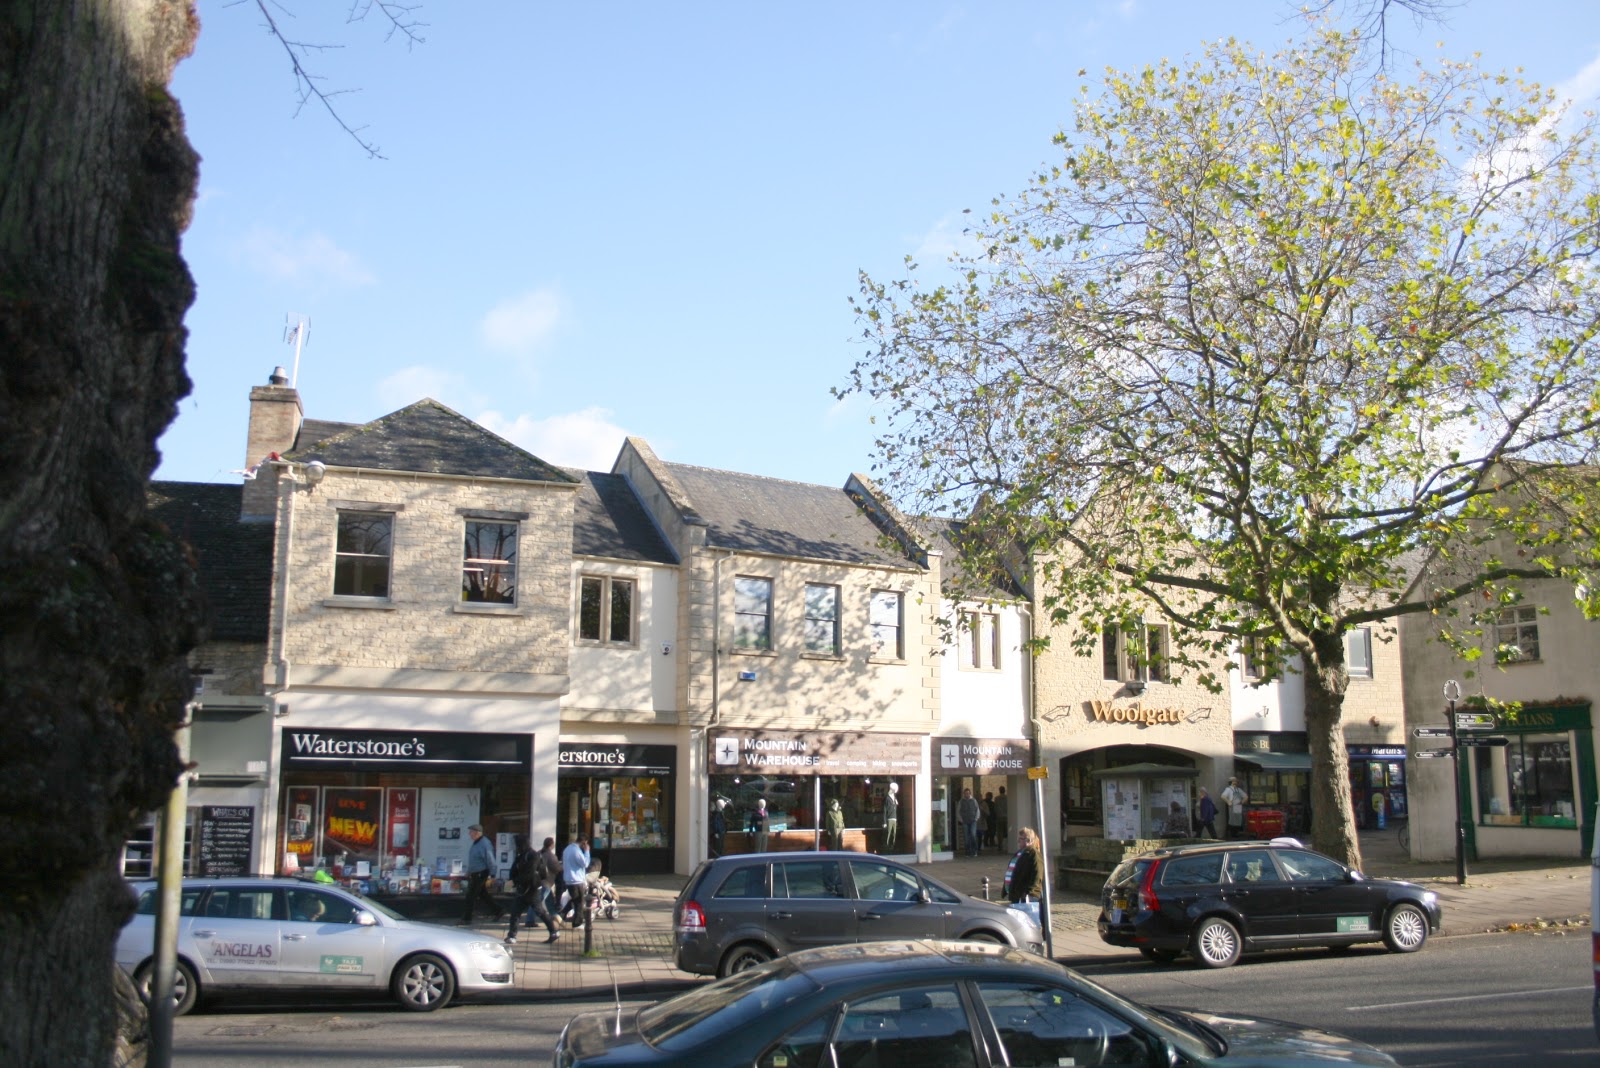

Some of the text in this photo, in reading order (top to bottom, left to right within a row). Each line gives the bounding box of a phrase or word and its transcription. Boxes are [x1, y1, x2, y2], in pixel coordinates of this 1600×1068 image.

[1089, 699, 1185, 726] Woolgate
[291, 733, 426, 756] Waterstone's
[744, 738, 807, 751] MOUNTAIN
[963, 744, 1013, 755] MOUNTAIN
[558, 748, 626, 764] erstone's
[744, 753, 820, 766] WAREHOUSE
[963, 757, 1023, 769] WAREHOUSE
[212, 807, 250, 817] WHAT'S ON
[329, 816, 379, 839] NEW
[287, 842, 314, 854] NEW
